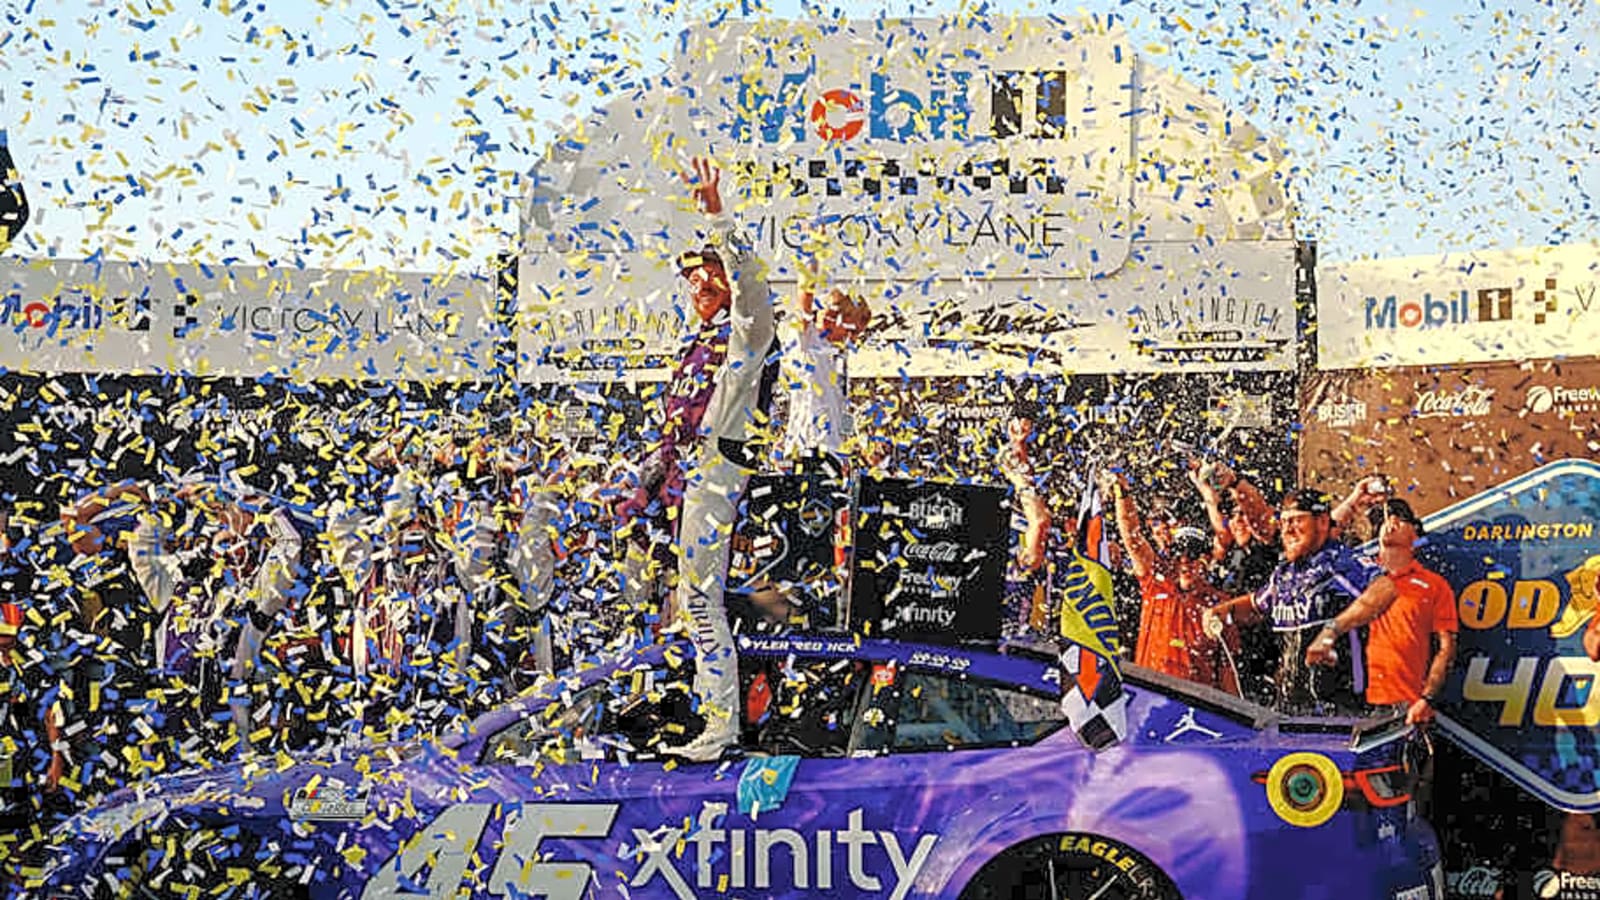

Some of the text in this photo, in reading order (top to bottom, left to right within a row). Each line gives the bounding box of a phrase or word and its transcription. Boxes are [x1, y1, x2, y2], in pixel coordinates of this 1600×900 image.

[742, 212, 1065, 249] VICORY LANE
[1365, 290, 1469, 329] Mobil
[909, 502, 963, 525] BUSCH
[1463, 523, 1594, 541] DARLINGTON
[742, 639, 789, 651] YLER
[630, 800, 938, 900] xfinity
[1060, 836, 1136, 872] EAGLE
